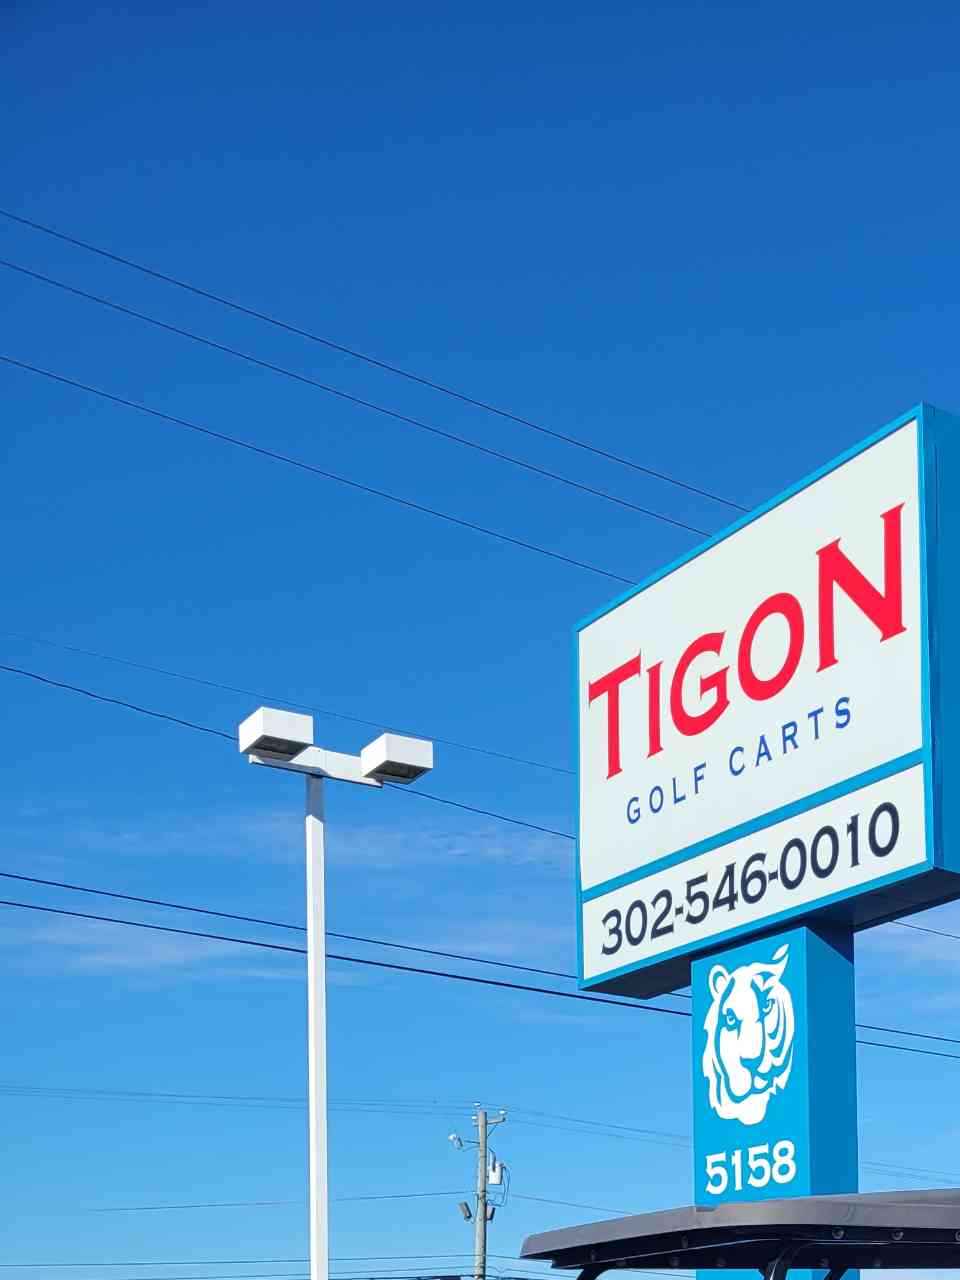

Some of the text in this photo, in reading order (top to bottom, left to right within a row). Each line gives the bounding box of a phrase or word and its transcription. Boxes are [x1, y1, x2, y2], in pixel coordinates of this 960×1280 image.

[588, 502, 907, 780] TIGON
[626, 696, 851, 825] GOLF CARTS
[600, 801, 900, 956] 302-546-0010
[705, 1139, 796, 1195] 5158
